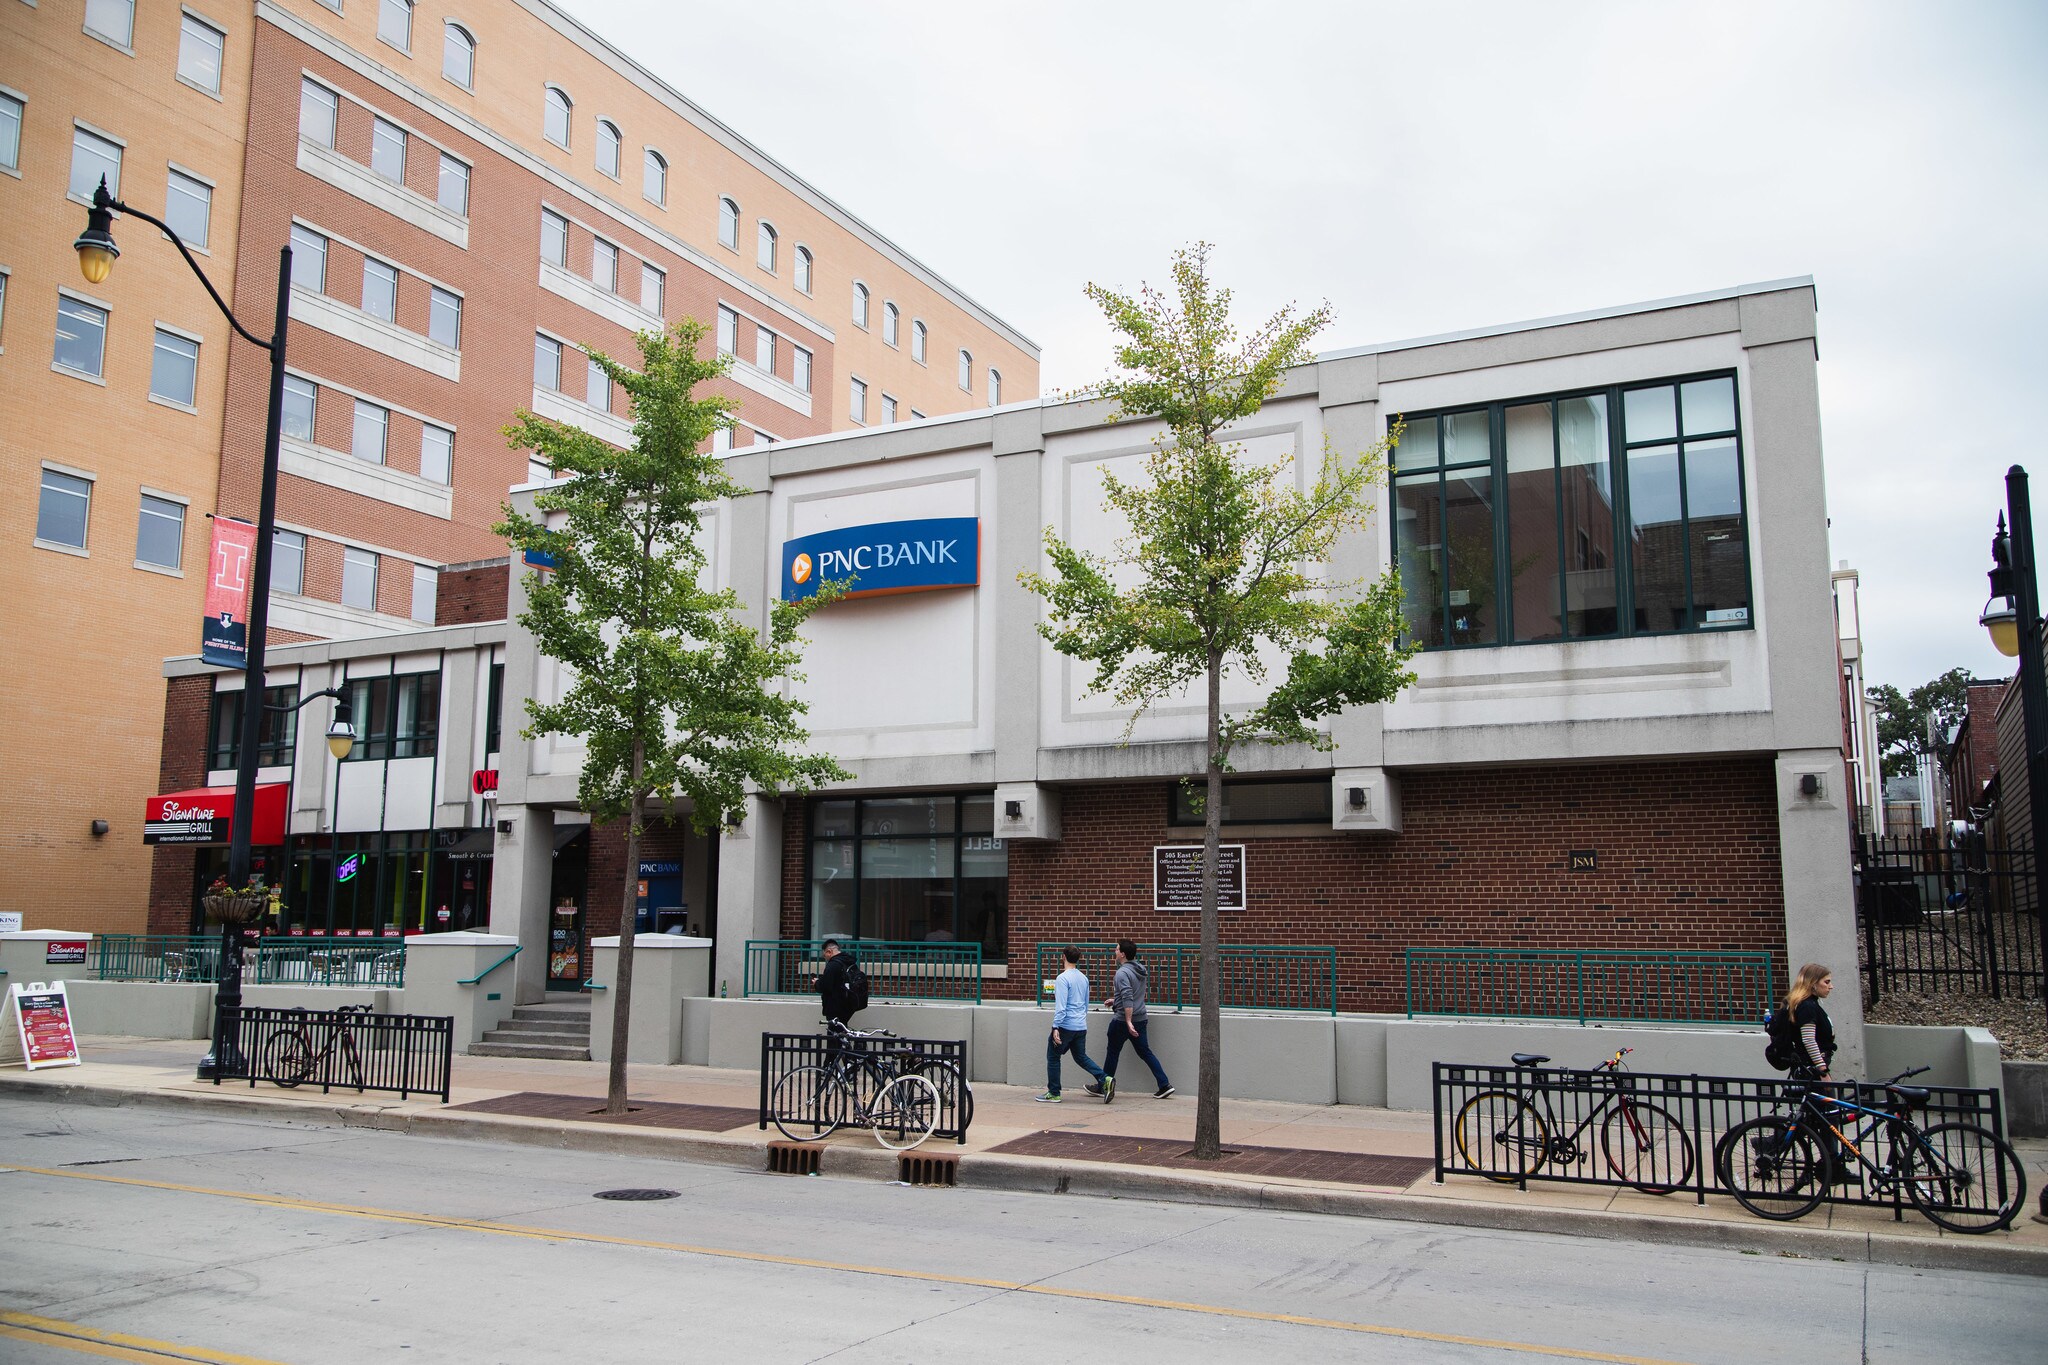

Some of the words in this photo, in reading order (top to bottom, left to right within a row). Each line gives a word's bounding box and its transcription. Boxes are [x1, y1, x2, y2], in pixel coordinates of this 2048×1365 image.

[818, 546, 871, 576] PNC
[875, 539, 958, 568] BANK
[162, 801, 215, 821] SIGNATURE
[190, 822, 212, 833] GRILL
[338, 858, 358, 879] OPE
[640, 864, 657, 872] PNC
[658, 864, 680, 872] BANK
[1573, 856, 1594, 868] JSM
